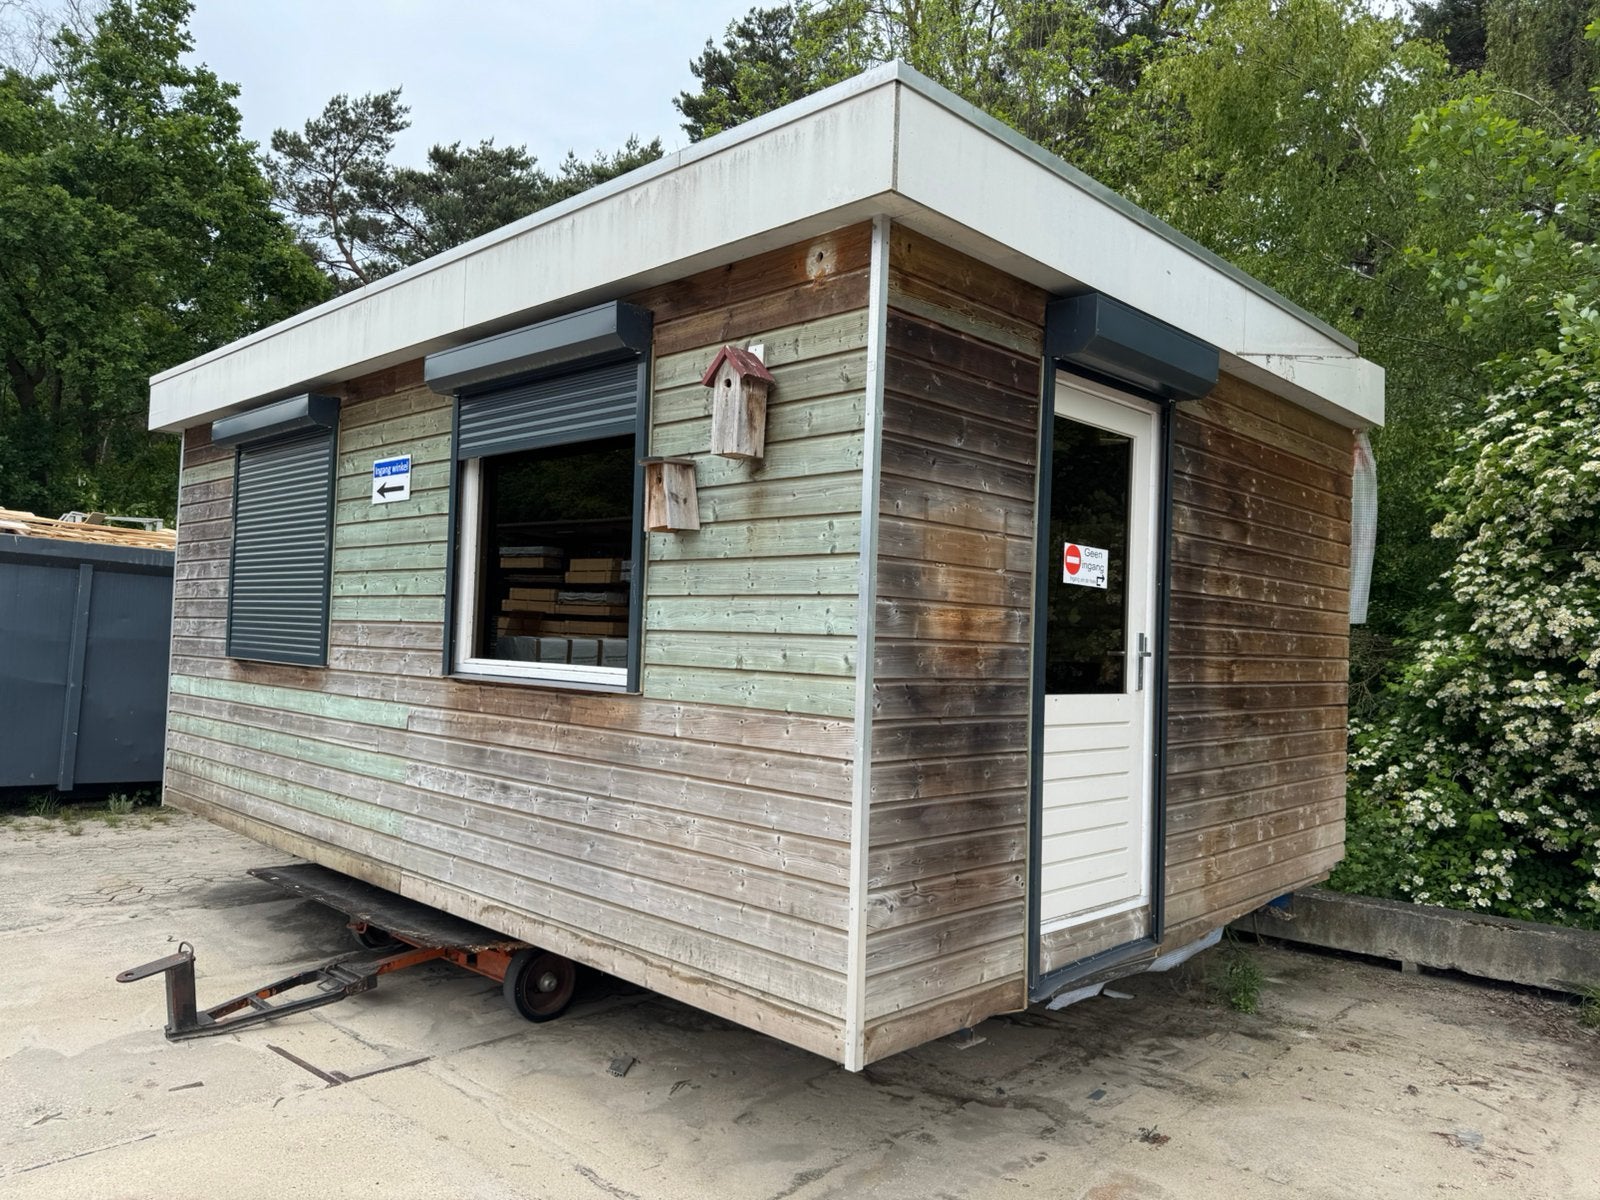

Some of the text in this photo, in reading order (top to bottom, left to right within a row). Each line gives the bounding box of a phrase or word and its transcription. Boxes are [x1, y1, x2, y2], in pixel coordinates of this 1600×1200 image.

[375, 461, 408, 477] Ingang winkel
[1084, 548, 1103, 559] Geen
